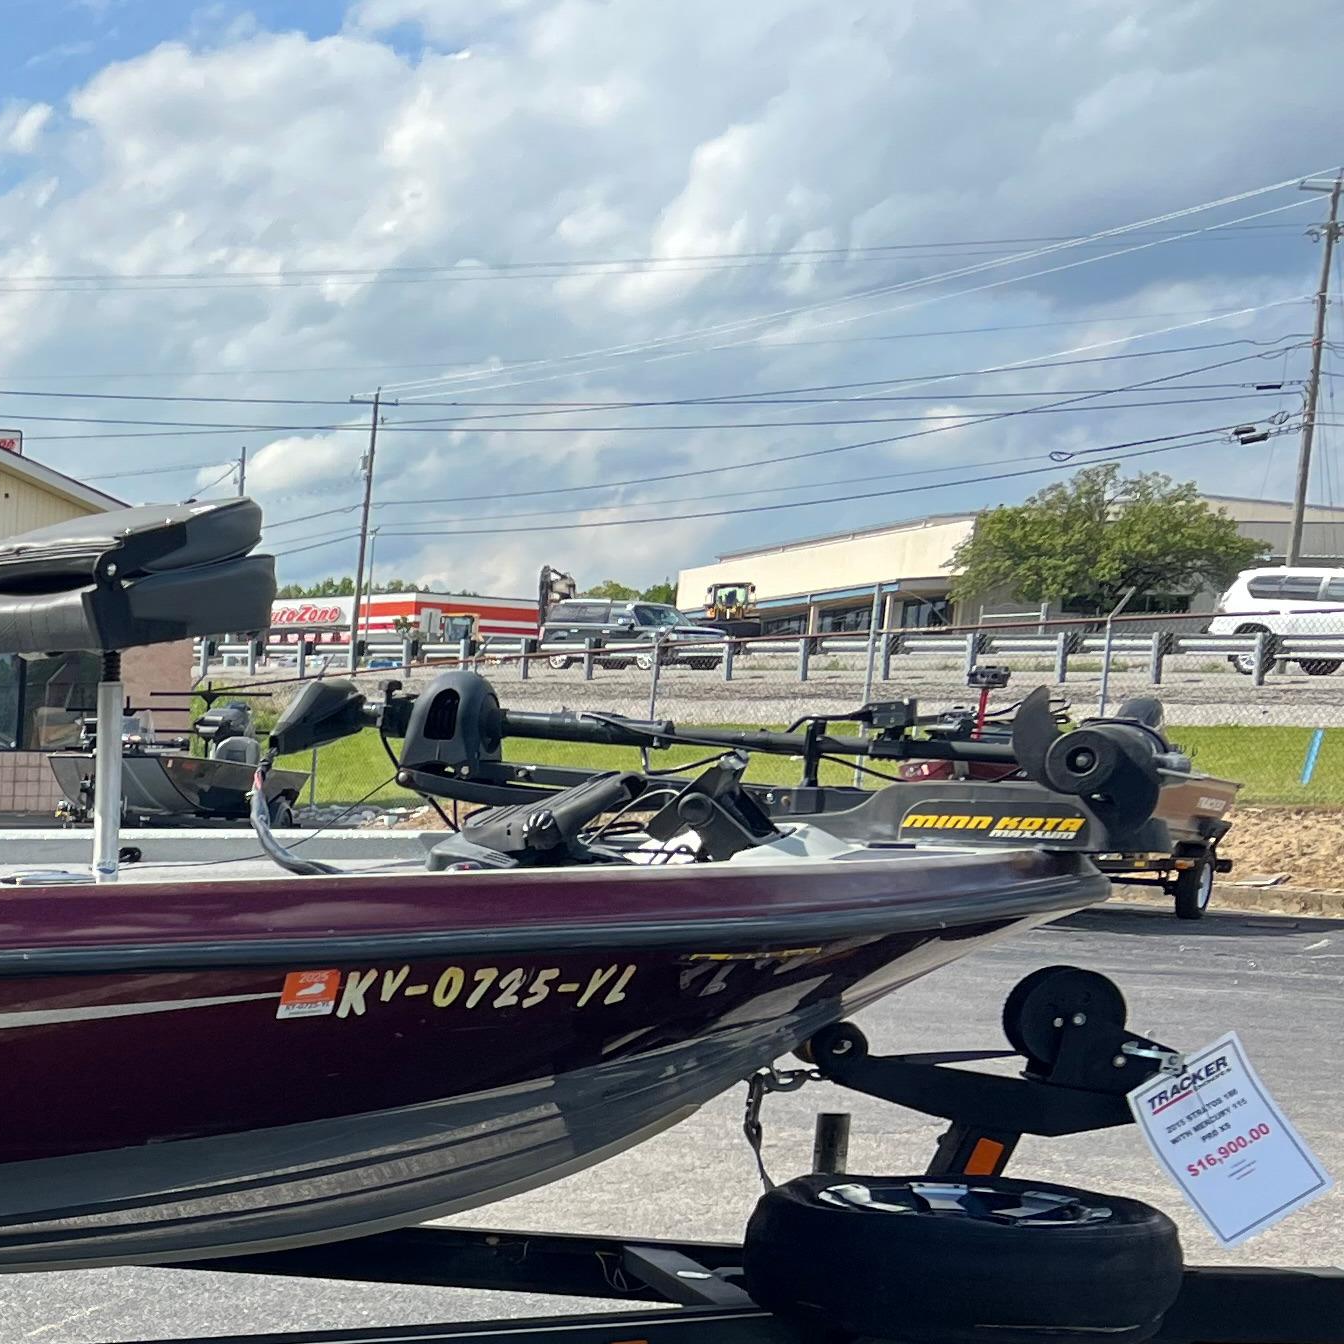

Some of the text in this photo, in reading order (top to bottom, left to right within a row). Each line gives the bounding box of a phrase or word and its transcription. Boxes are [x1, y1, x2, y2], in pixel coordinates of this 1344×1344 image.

[270, 604, 340, 624] utoZone
[996, 818, 1086, 831] KOTA
[336, 964, 637, 1018] KY-0725-YL
[1147, 1056, 1228, 1110] TRACKER
[1186, 1122, 1271, 1177] $16,900.00
